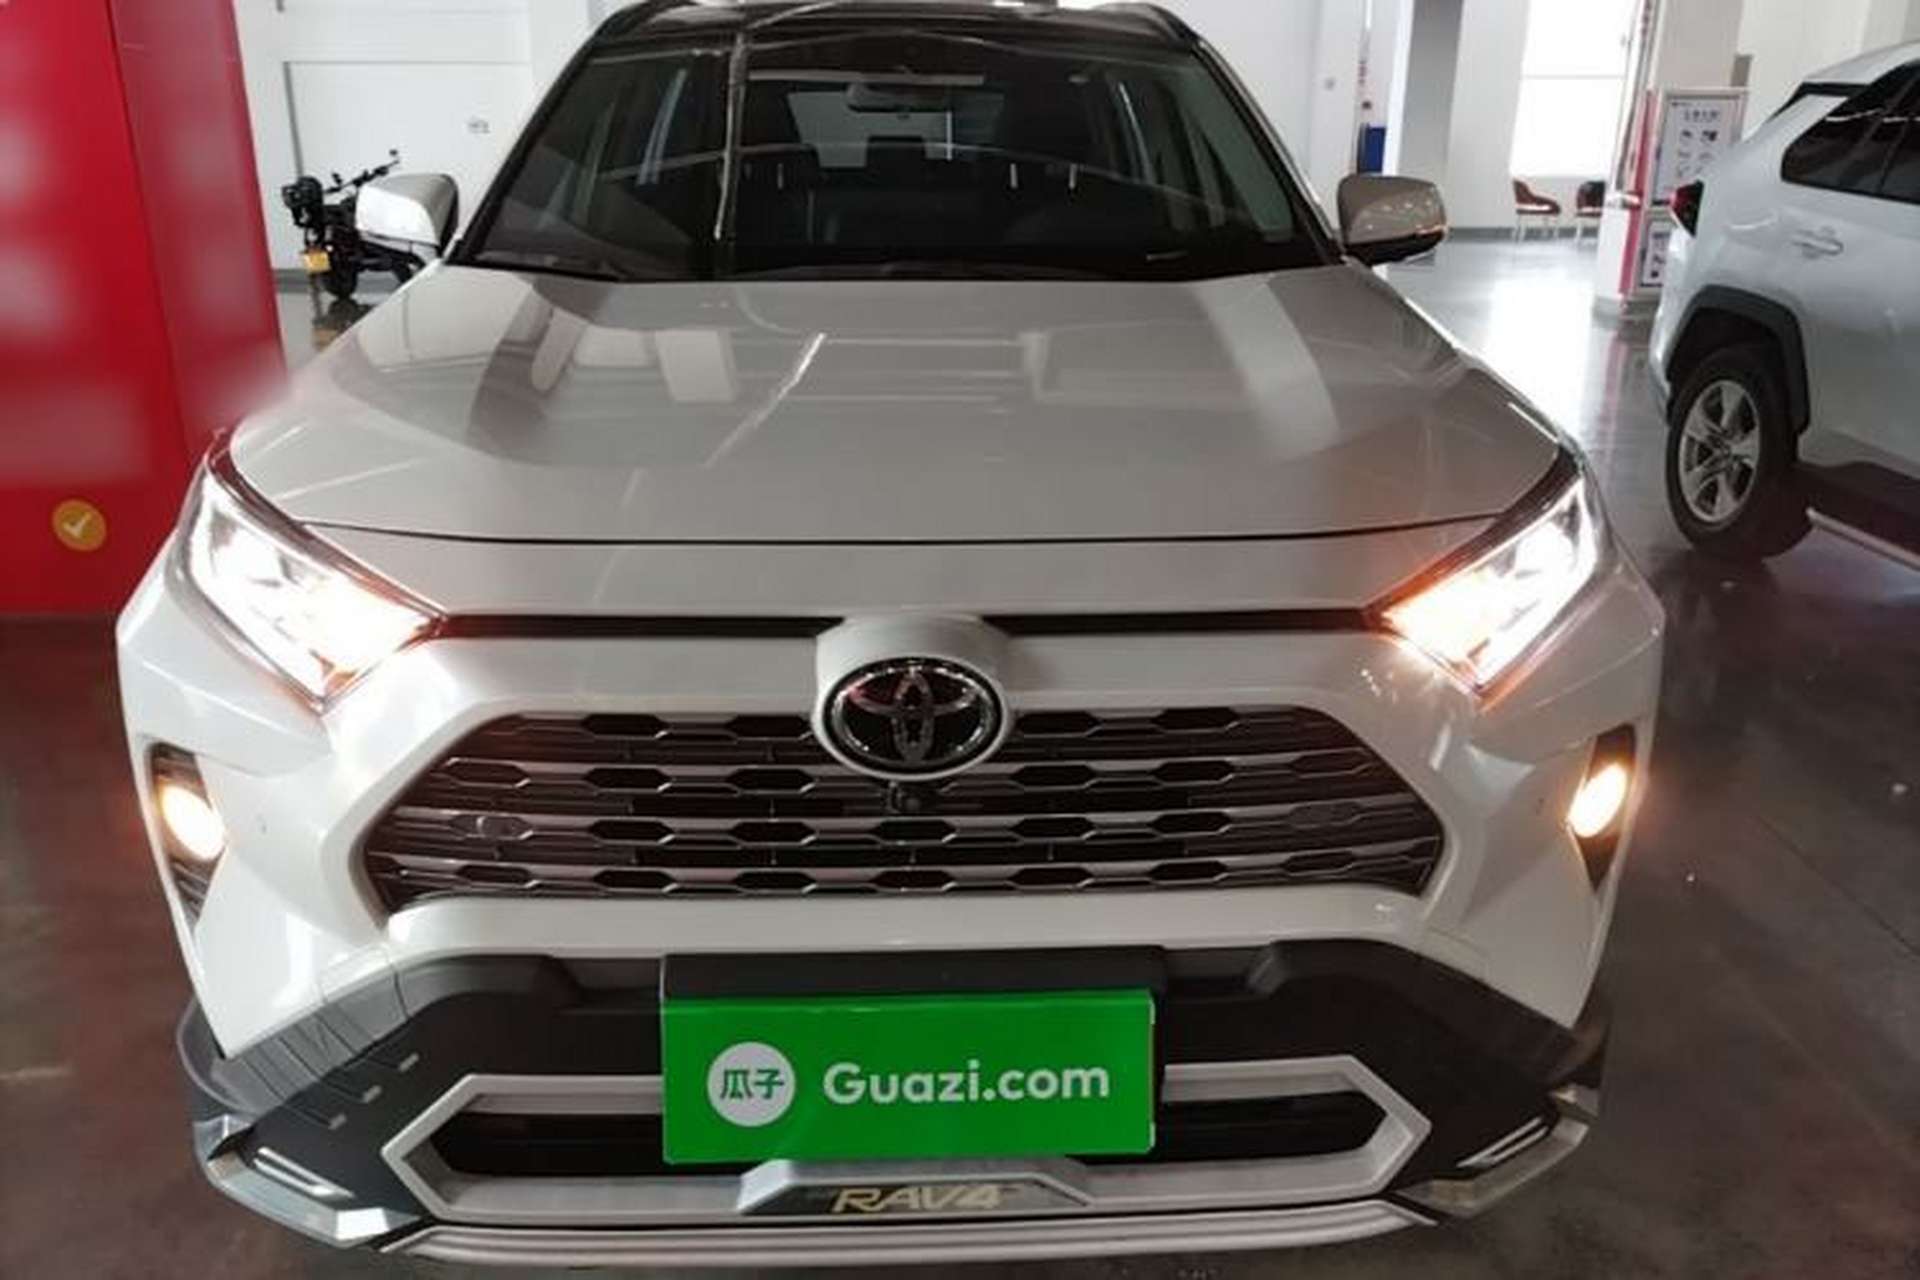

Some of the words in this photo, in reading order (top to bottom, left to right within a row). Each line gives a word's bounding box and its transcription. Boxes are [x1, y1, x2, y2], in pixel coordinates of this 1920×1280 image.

[720, 1068, 785, 1100] 瓜子
[823, 1059, 1110, 1104] Guazi.com
[831, 1183, 1000, 1213] RAV4
